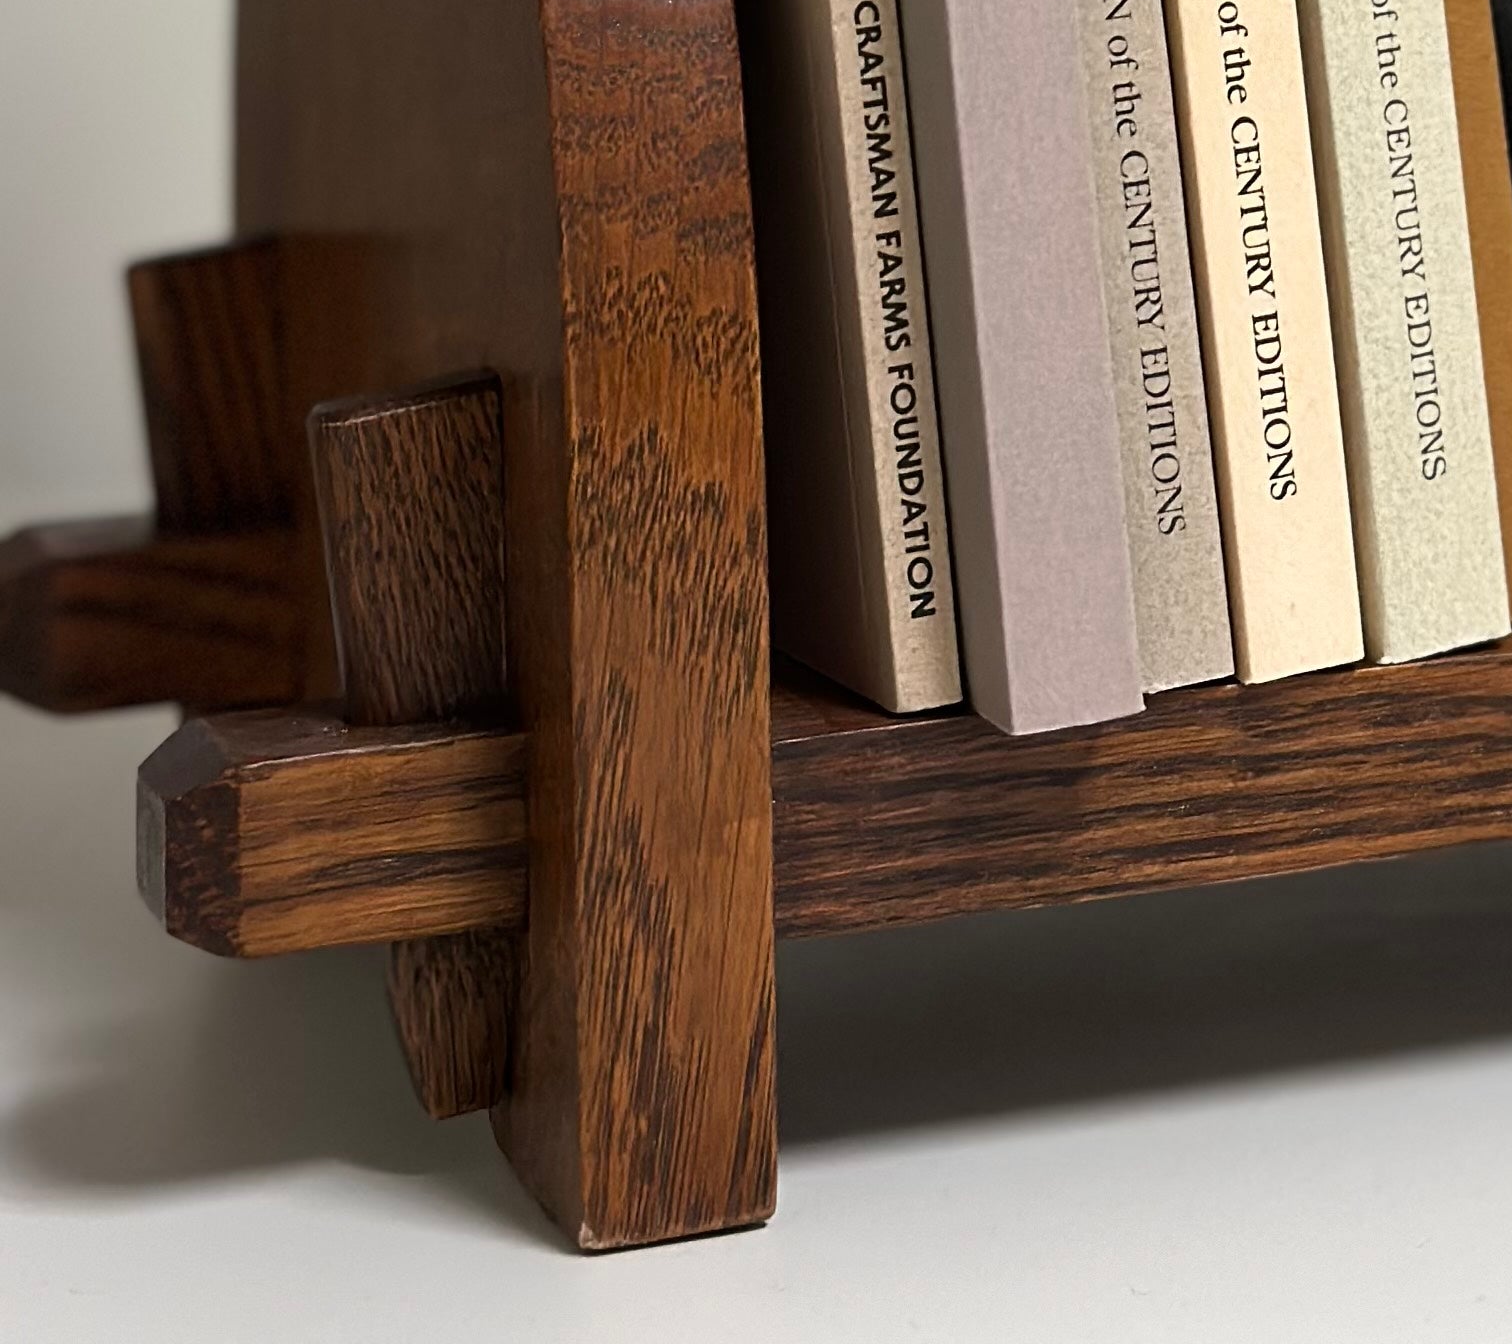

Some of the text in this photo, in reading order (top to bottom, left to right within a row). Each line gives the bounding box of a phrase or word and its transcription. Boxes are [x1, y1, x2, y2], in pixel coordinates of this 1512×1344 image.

[1108, 35, 1138, 73] of
[1113, 79, 1142, 137] the
[1218, 0, 1248, 36] of
[1223, 46, 1248, 103] the
[1373, 31, 1398, 89] the
[853, 0, 898, 219] CRAFTSMAN
[1384, 99, 1427, 281] CENTURY
[875, 230, 911, 352] FARMS
[1120, 150, 1169, 333] CENTURY
[1230, 116, 1275, 298] CENTURY
[1139, 343, 1187, 538] EDITIONS
[1251, 313, 1297, 501] EDITIONS
[1405, 292, 1446, 482] EDITIONS
[887, 362, 936, 620] FOUNDATION
